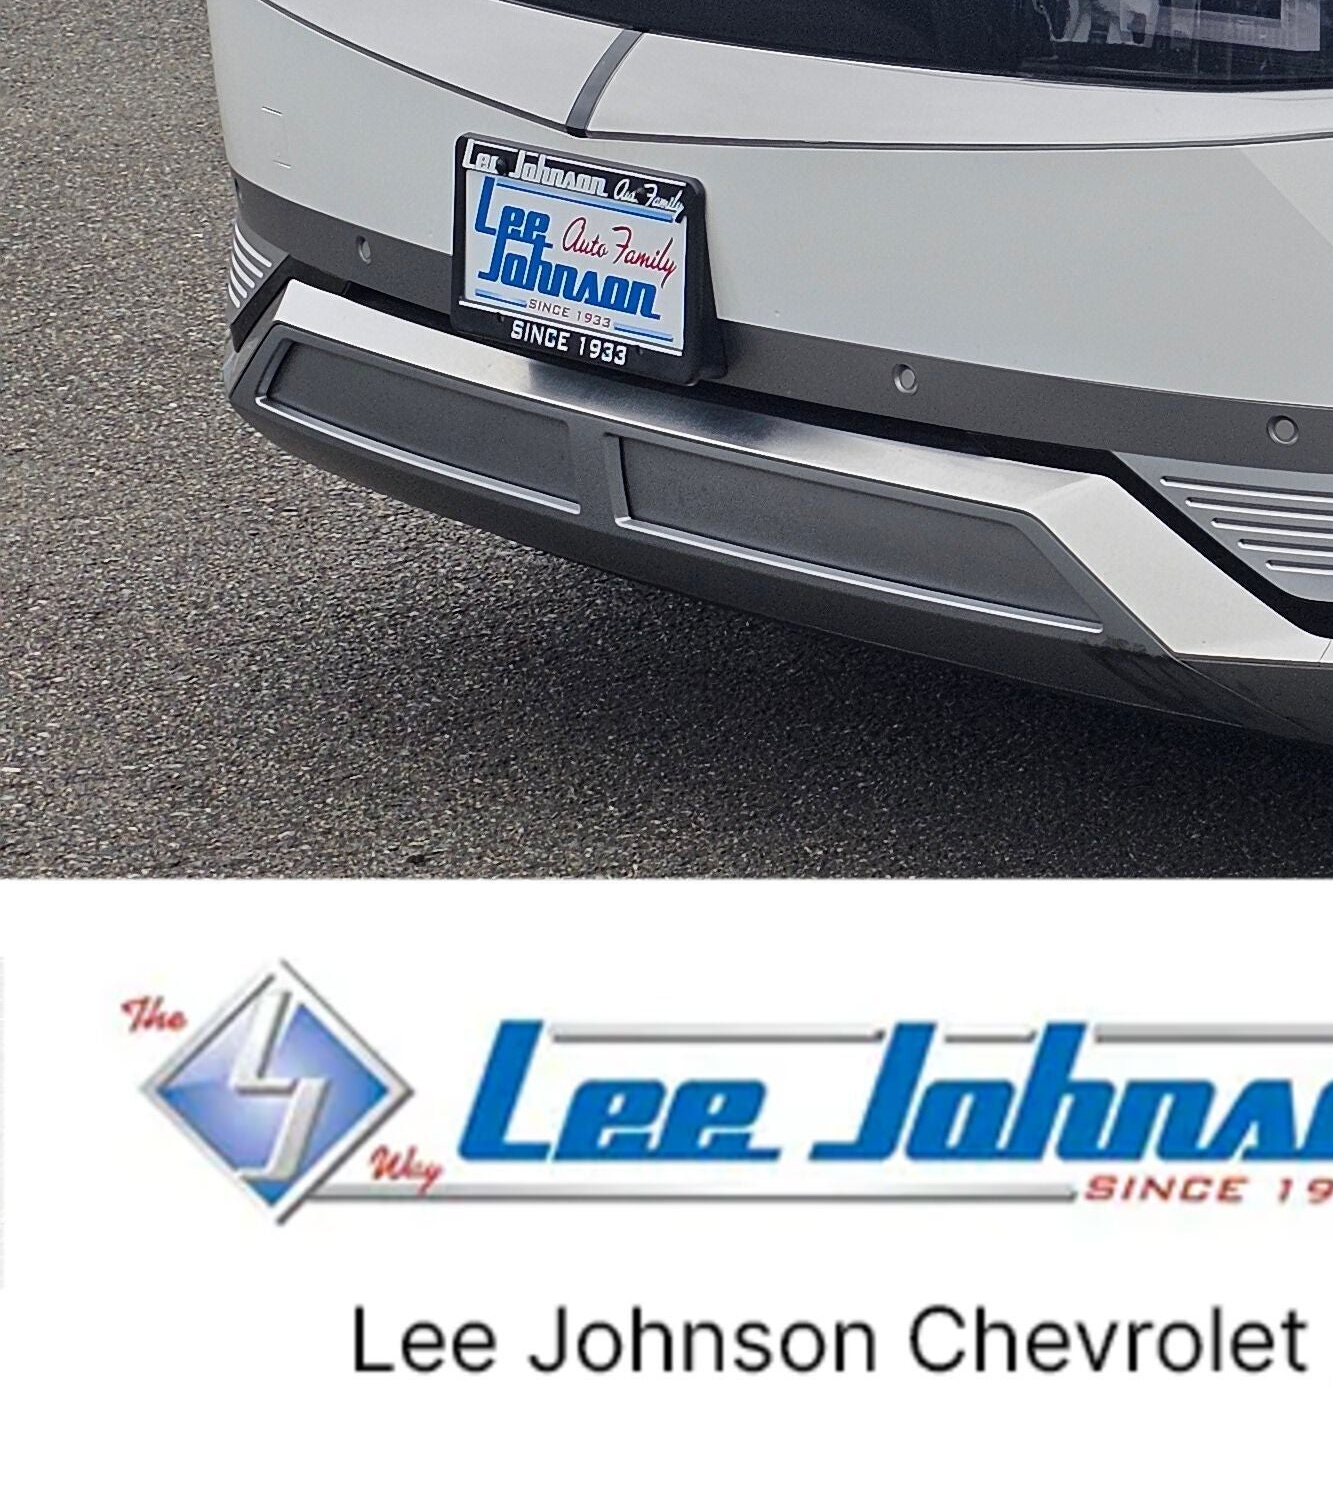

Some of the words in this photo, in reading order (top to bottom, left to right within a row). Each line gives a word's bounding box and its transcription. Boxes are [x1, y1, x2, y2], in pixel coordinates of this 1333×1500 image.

[474, 176, 553, 249] Lee
[478, 228, 661, 320] Johnson
[562, 217, 609, 258] Auto
[611, 226, 677, 288] Family
[510, 321, 571, 351] SINCE
[579, 337, 627, 366] 1933
[527, 299, 571, 318] SINCE
[576, 311, 611, 329] 1933
